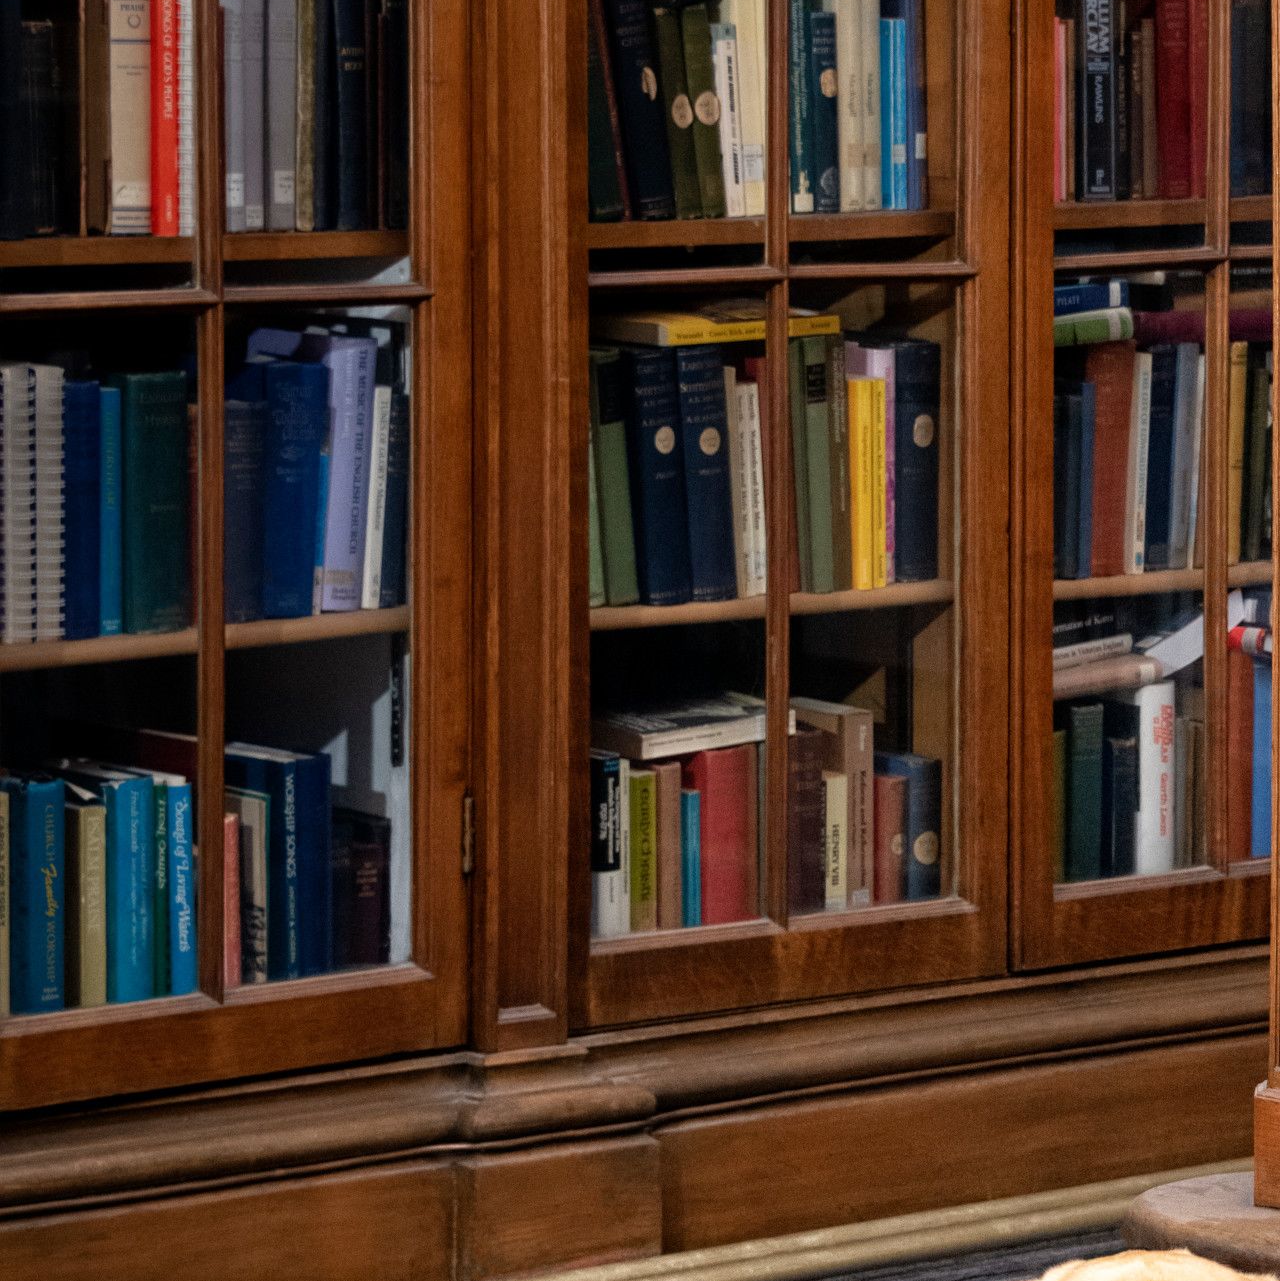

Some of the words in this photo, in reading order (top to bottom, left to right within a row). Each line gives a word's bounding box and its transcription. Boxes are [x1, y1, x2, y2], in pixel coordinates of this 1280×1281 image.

[359, 350, 369, 369] THE
[358, 375, 368, 408] MUSIC
[355, 431, 365, 451] THE
[356, 412, 366, 427] OF
[352, 456, 364, 505] ENGLISH
[349, 507, 360, 555] CHURCH
[284, 772, 296, 833] WORSHIP
[45, 804, 57, 862] CHURCH
[831, 823, 841, 865] HENRY
[285, 834, 297, 879] SONGS
[831, 866, 840, 887] VIII
[46, 920, 57, 984] WORSHIP
